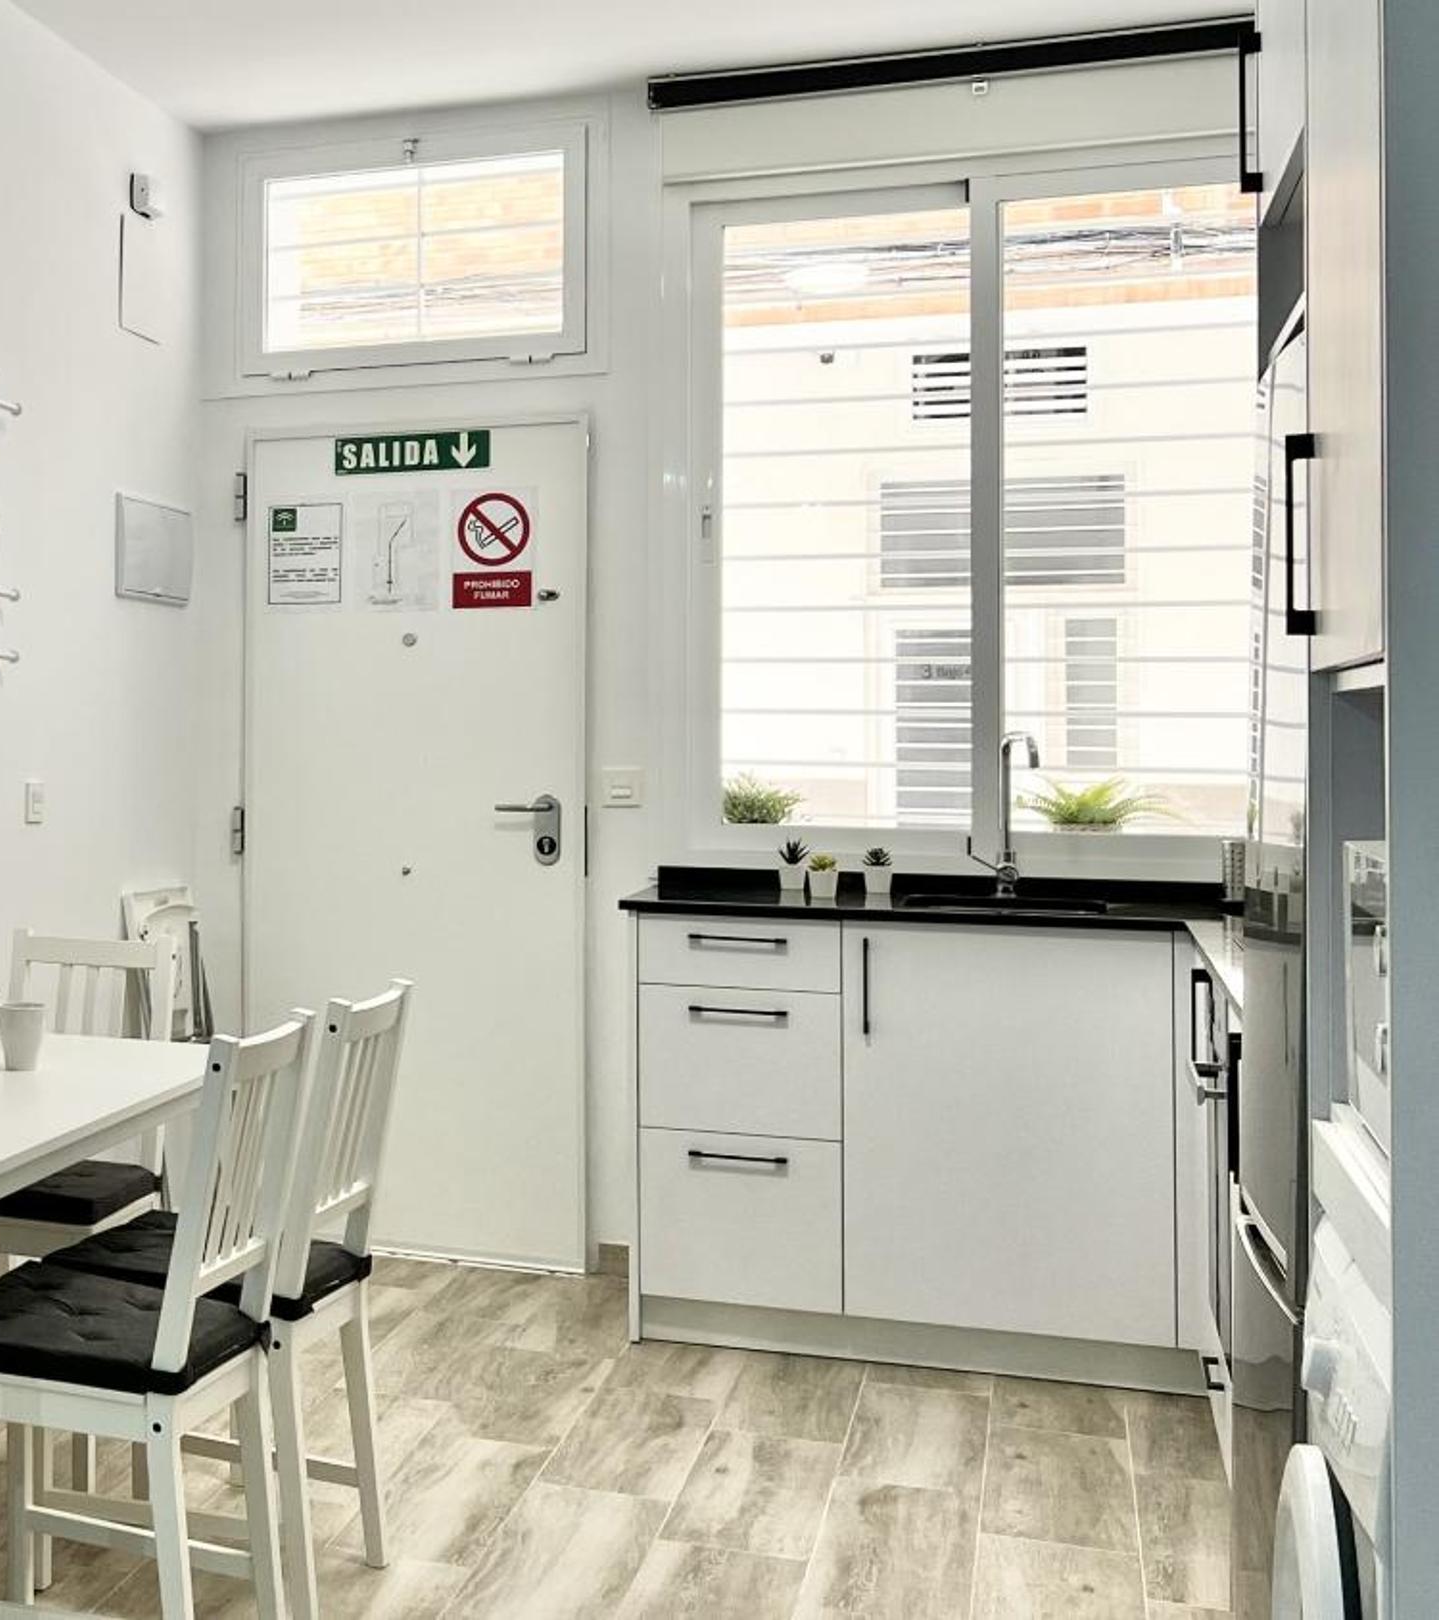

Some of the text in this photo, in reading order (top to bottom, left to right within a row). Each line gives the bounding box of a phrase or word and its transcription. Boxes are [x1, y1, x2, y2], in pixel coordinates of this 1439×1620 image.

[342, 439, 439, 469] SALIDA
[463, 578, 520, 590] PROHIBIDO
[473, 591, 510, 600] FUMAR
